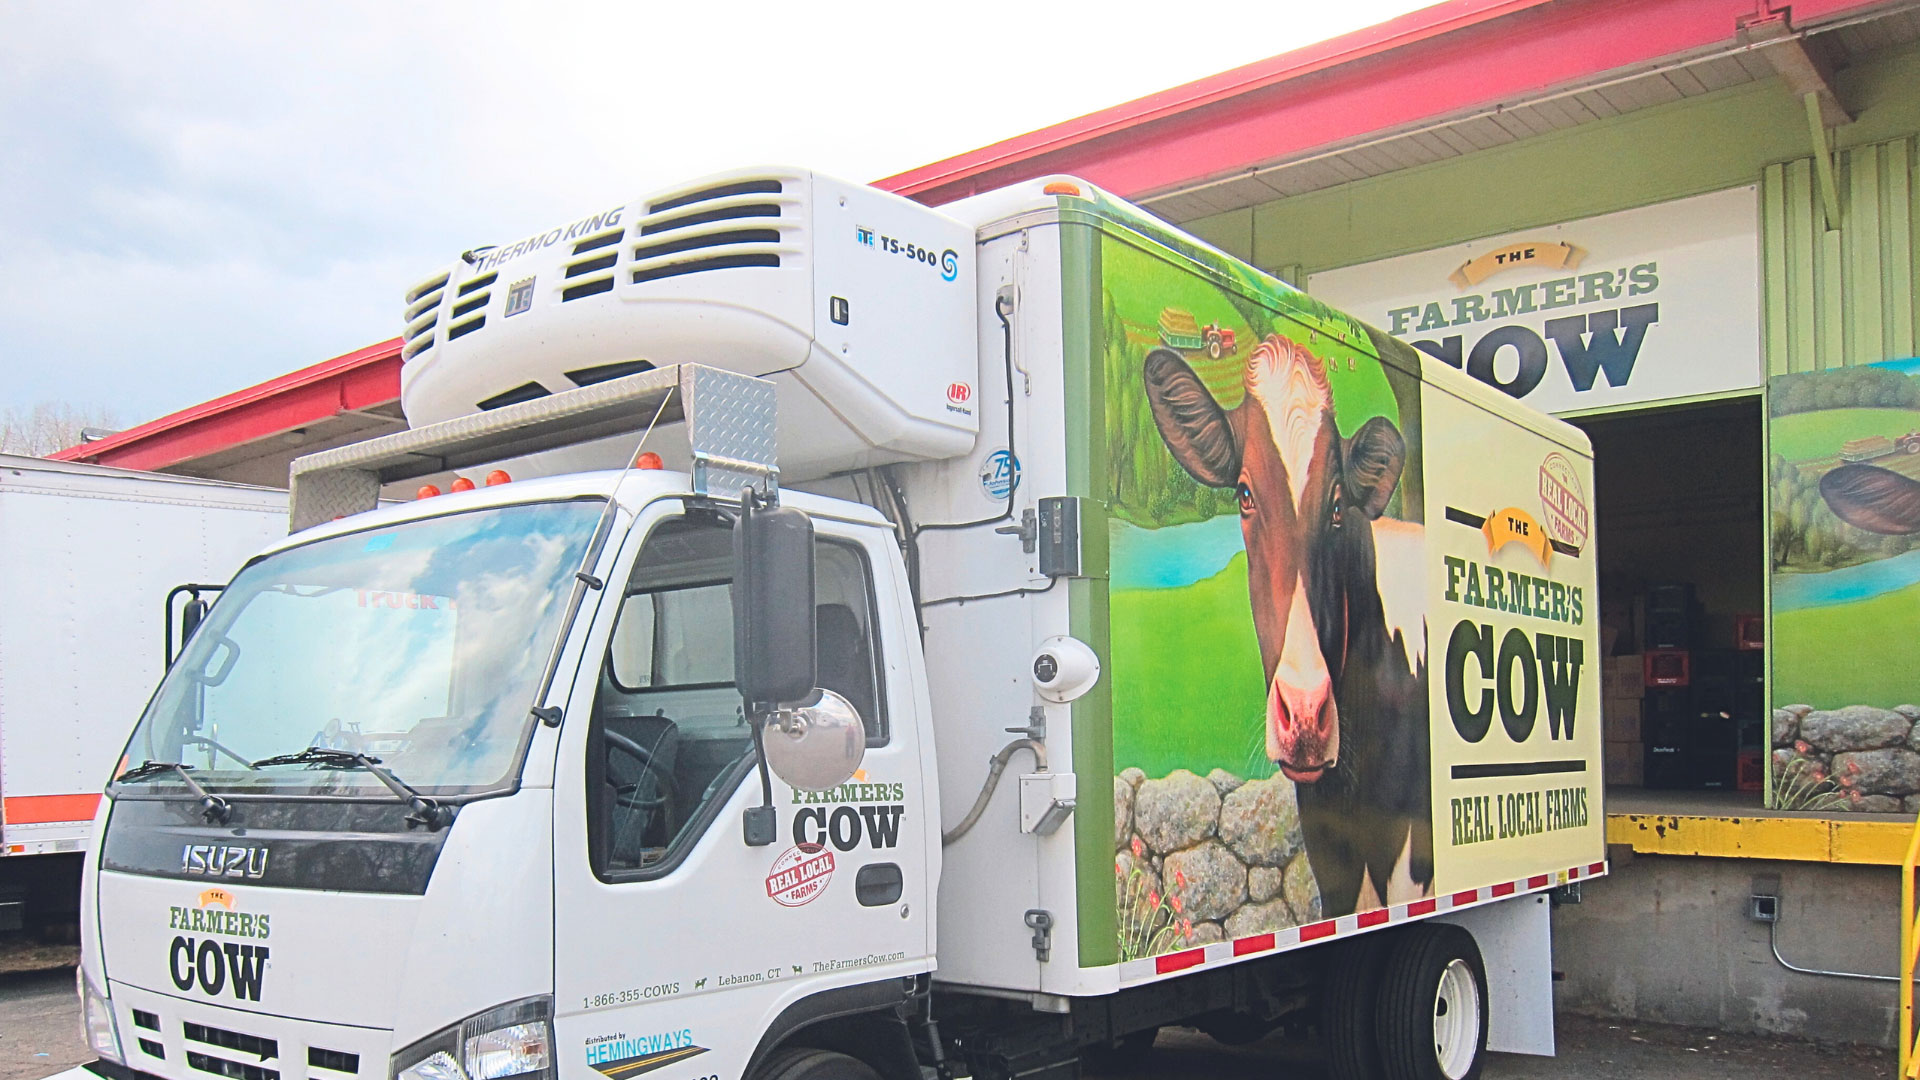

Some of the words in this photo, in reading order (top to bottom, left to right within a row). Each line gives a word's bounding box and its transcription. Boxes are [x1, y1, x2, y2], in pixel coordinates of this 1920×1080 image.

[475, 229, 562, 273] THERMO
[563, 206, 625, 241] KING
[881, 235, 936, 266] TS-500
[1495, 248, 1535, 265] THE
[1388, 262, 1659, 336] FARMER'S
[951, 384, 966, 401] IR
[1542, 471, 1562, 512] REAL
[1564, 492, 1586, 536] LOCAL
[1508, 517, 1529, 536] THE
[1554, 516, 1574, 544] FARMS
[1444, 555, 1584, 625] FARMER'S
[1445, 619, 1584, 743] COW
[793, 805, 904, 854] COW
[1451, 796, 1493, 845] REAL
[1497, 792, 1542, 839] LOCAL
[1546, 787, 1588, 831] FARMS
[182, 844, 269, 879] ISUZU
[769, 870, 799, 893] REAL
[799, 856, 832, 881] LOCAL
[791, 881, 818, 900] FARMS
[169, 906, 270, 939] FARMER'S
[170, 935, 269, 1002] COW
[583, 982, 680, 1008] 1-866-355-COWS
[718, 972, 765, 986] Lebanon,
[767, 968, 781, 979] CT
[813, 951, 905, 972] TheFarmersCow.com
[585, 1033, 617, 1045] distributed
[620, 1032, 626, 1040] by
[586, 1029, 692, 1065] HEMINGWAYS
